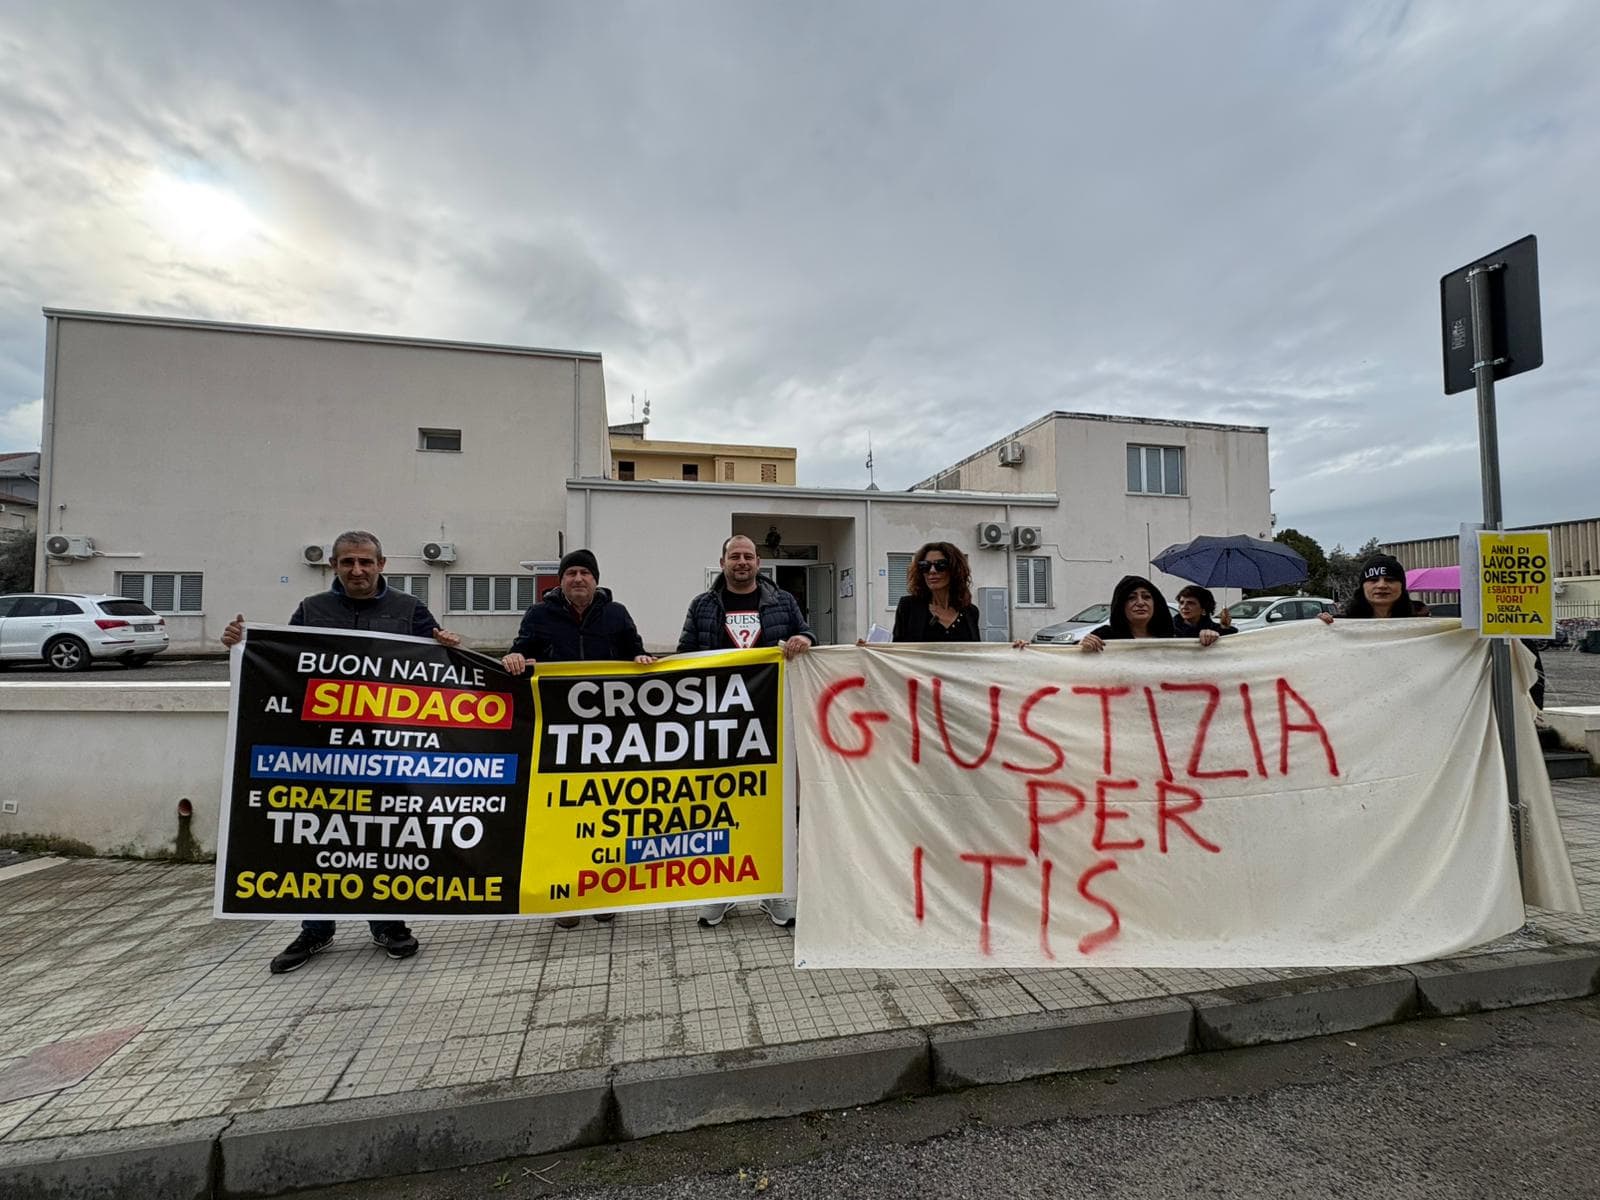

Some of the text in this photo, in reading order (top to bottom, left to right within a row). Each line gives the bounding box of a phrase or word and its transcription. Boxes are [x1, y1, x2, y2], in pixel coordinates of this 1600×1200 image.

[1483, 555, 1546, 569] LAVORO
[1491, 545, 1513, 554] ANNI
[1365, 567, 1387, 578] LOVE
[1484, 570, 1546, 584] ONESTO
[1492, 586, 1538, 594] SBATTUTI
[1496, 595, 1522, 604] FUORI
[726, 615, 760, 624] GUESS
[1487, 611, 1543, 623] DIGNITÀ
[297, 652, 486, 687] BUON NATALE
[264, 682, 506, 724] AL SINDACO
[568, 674, 754, 718] CROSIA
[329, 728, 440, 748] E A TUTTA
[548, 718, 771, 765] TRADITA
[816, 676, 1340, 782] GIUSTIZIA
[249, 785, 506, 813] E GRAZIE PER AVERCI
[548, 770, 767, 808] I LAVORATORI
[267, 811, 484, 850] TRATTATO
[576, 802, 740, 838] IN STRADA,
[1026, 779, 1222, 857] PER
[316, 851, 430, 870] COME UNO
[592, 831, 724, 864] GLI "AMICI"
[236, 870, 503, 902] SCARTO SOCIALE
[550, 854, 760, 900] IN POLTRONA
[911, 846, 1120, 960] ITIS
